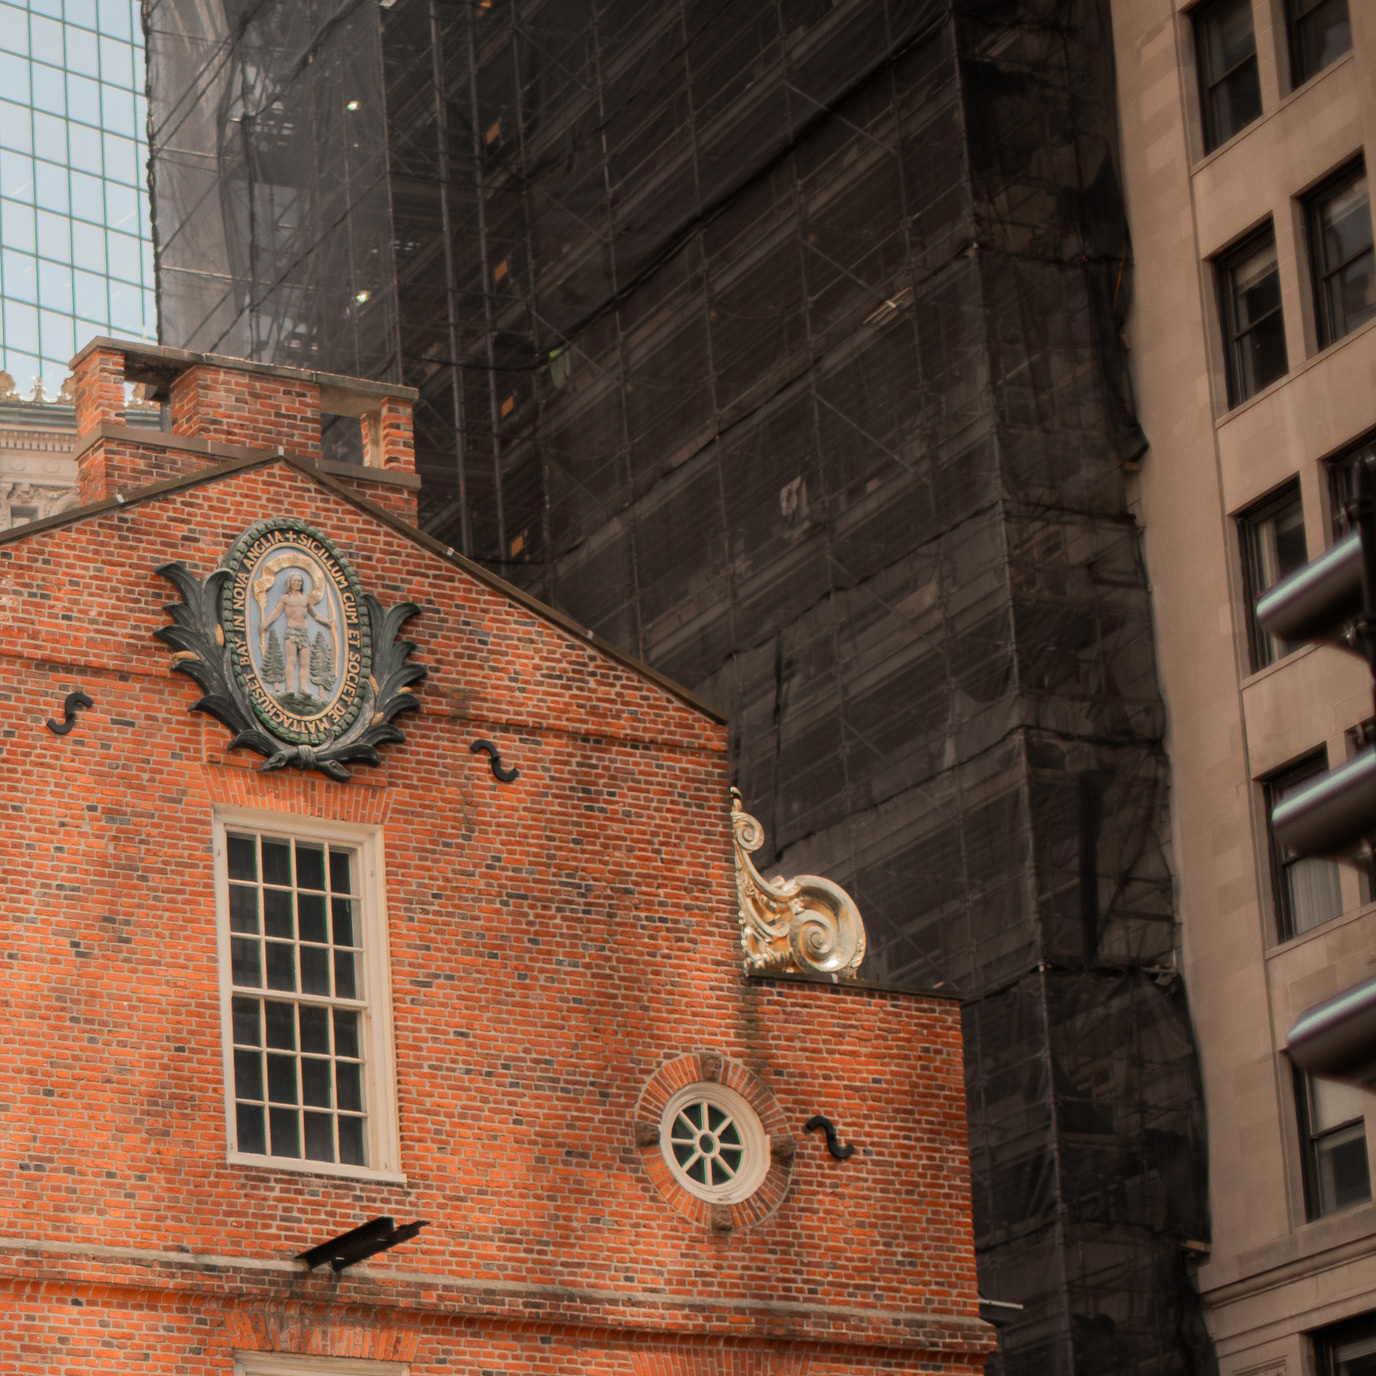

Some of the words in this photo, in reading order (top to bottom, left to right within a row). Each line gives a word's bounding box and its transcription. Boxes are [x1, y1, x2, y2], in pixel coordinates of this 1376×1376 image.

[242, 530, 285, 571] ANGLIA
[233, 572, 250, 610] NOVA
[233, 615, 245, 631] IN
[343, 592, 359, 624] CUM
[234, 637, 251, 666] BAY
[348, 629, 361, 648] ET
[340, 651, 361, 706] SOCIET
[243, 673, 331, 734] MATTACHUSET
[328, 703, 346, 723] DE
